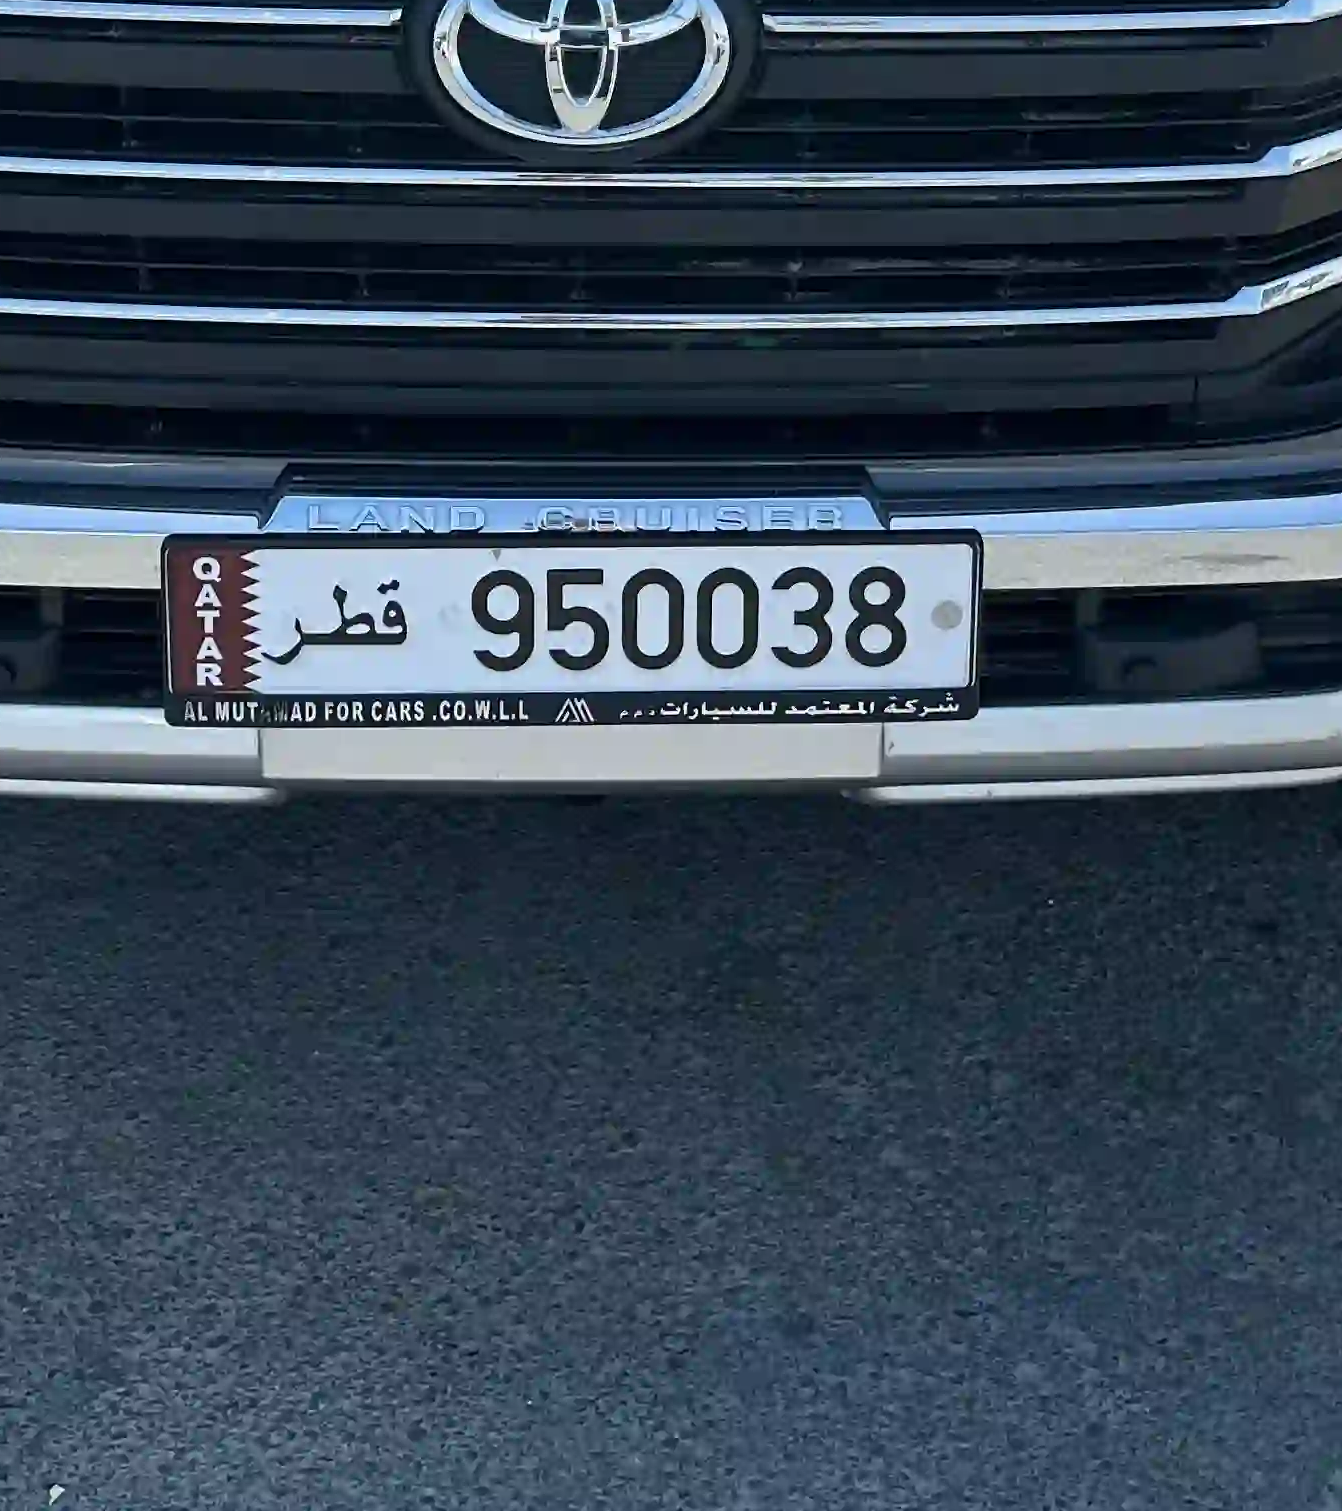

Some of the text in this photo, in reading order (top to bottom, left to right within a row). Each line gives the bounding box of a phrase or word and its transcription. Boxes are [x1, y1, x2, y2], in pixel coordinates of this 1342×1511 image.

[307, 503, 842, 532] LAND CRUISER
[192, 556, 224, 686] QATAR
[260, 579, 408, 666] قطر
[471, 566, 908, 672] 950038
[184, 700, 207, 722] AL
[324, 701, 364, 722] FOR
[371, 700, 425, 721] CARS
[660, 701, 777, 720] للسيارات
[785, 700, 875, 716] المعتمد
[883, 692, 960, 716] شركة
